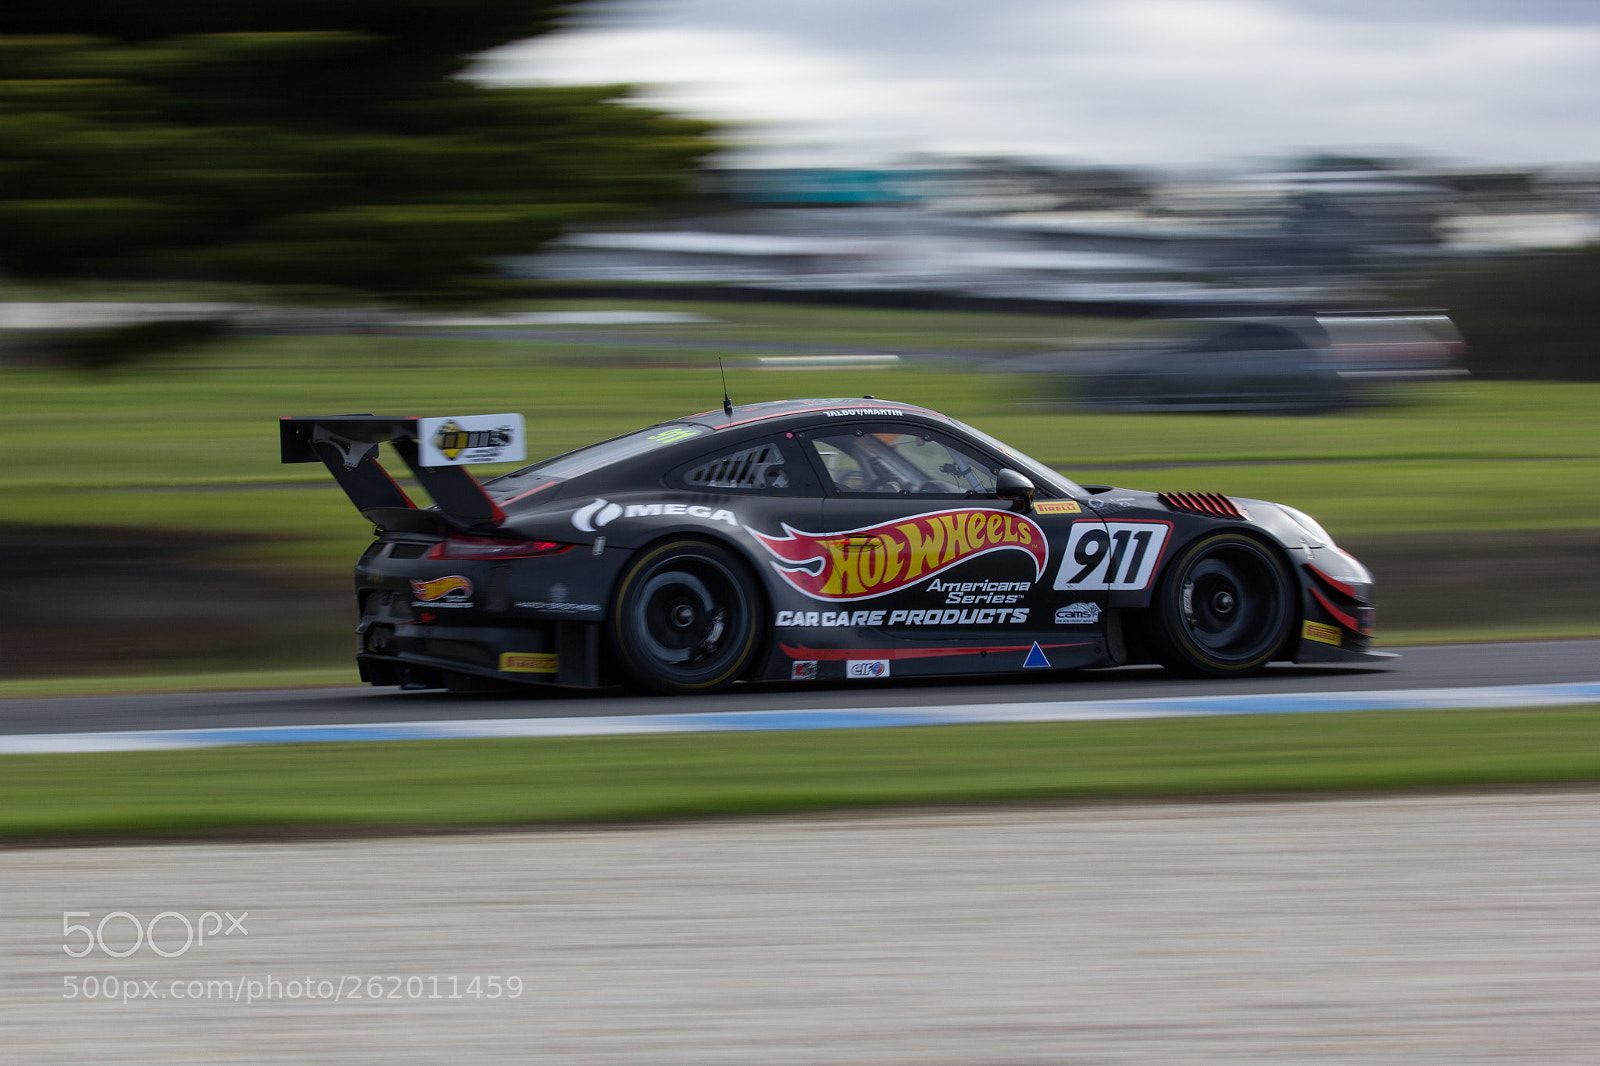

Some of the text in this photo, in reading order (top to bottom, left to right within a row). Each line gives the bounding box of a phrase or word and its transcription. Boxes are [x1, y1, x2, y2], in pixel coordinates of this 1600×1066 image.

[624, 503, 739, 526] MEGA
[1037, 503, 1076, 512] PIRELLI
[1066, 529, 1153, 584] 911
[926, 578, 1031, 592] Americana
[775, 608, 1029, 627] CAR CARE PRODUCTS
